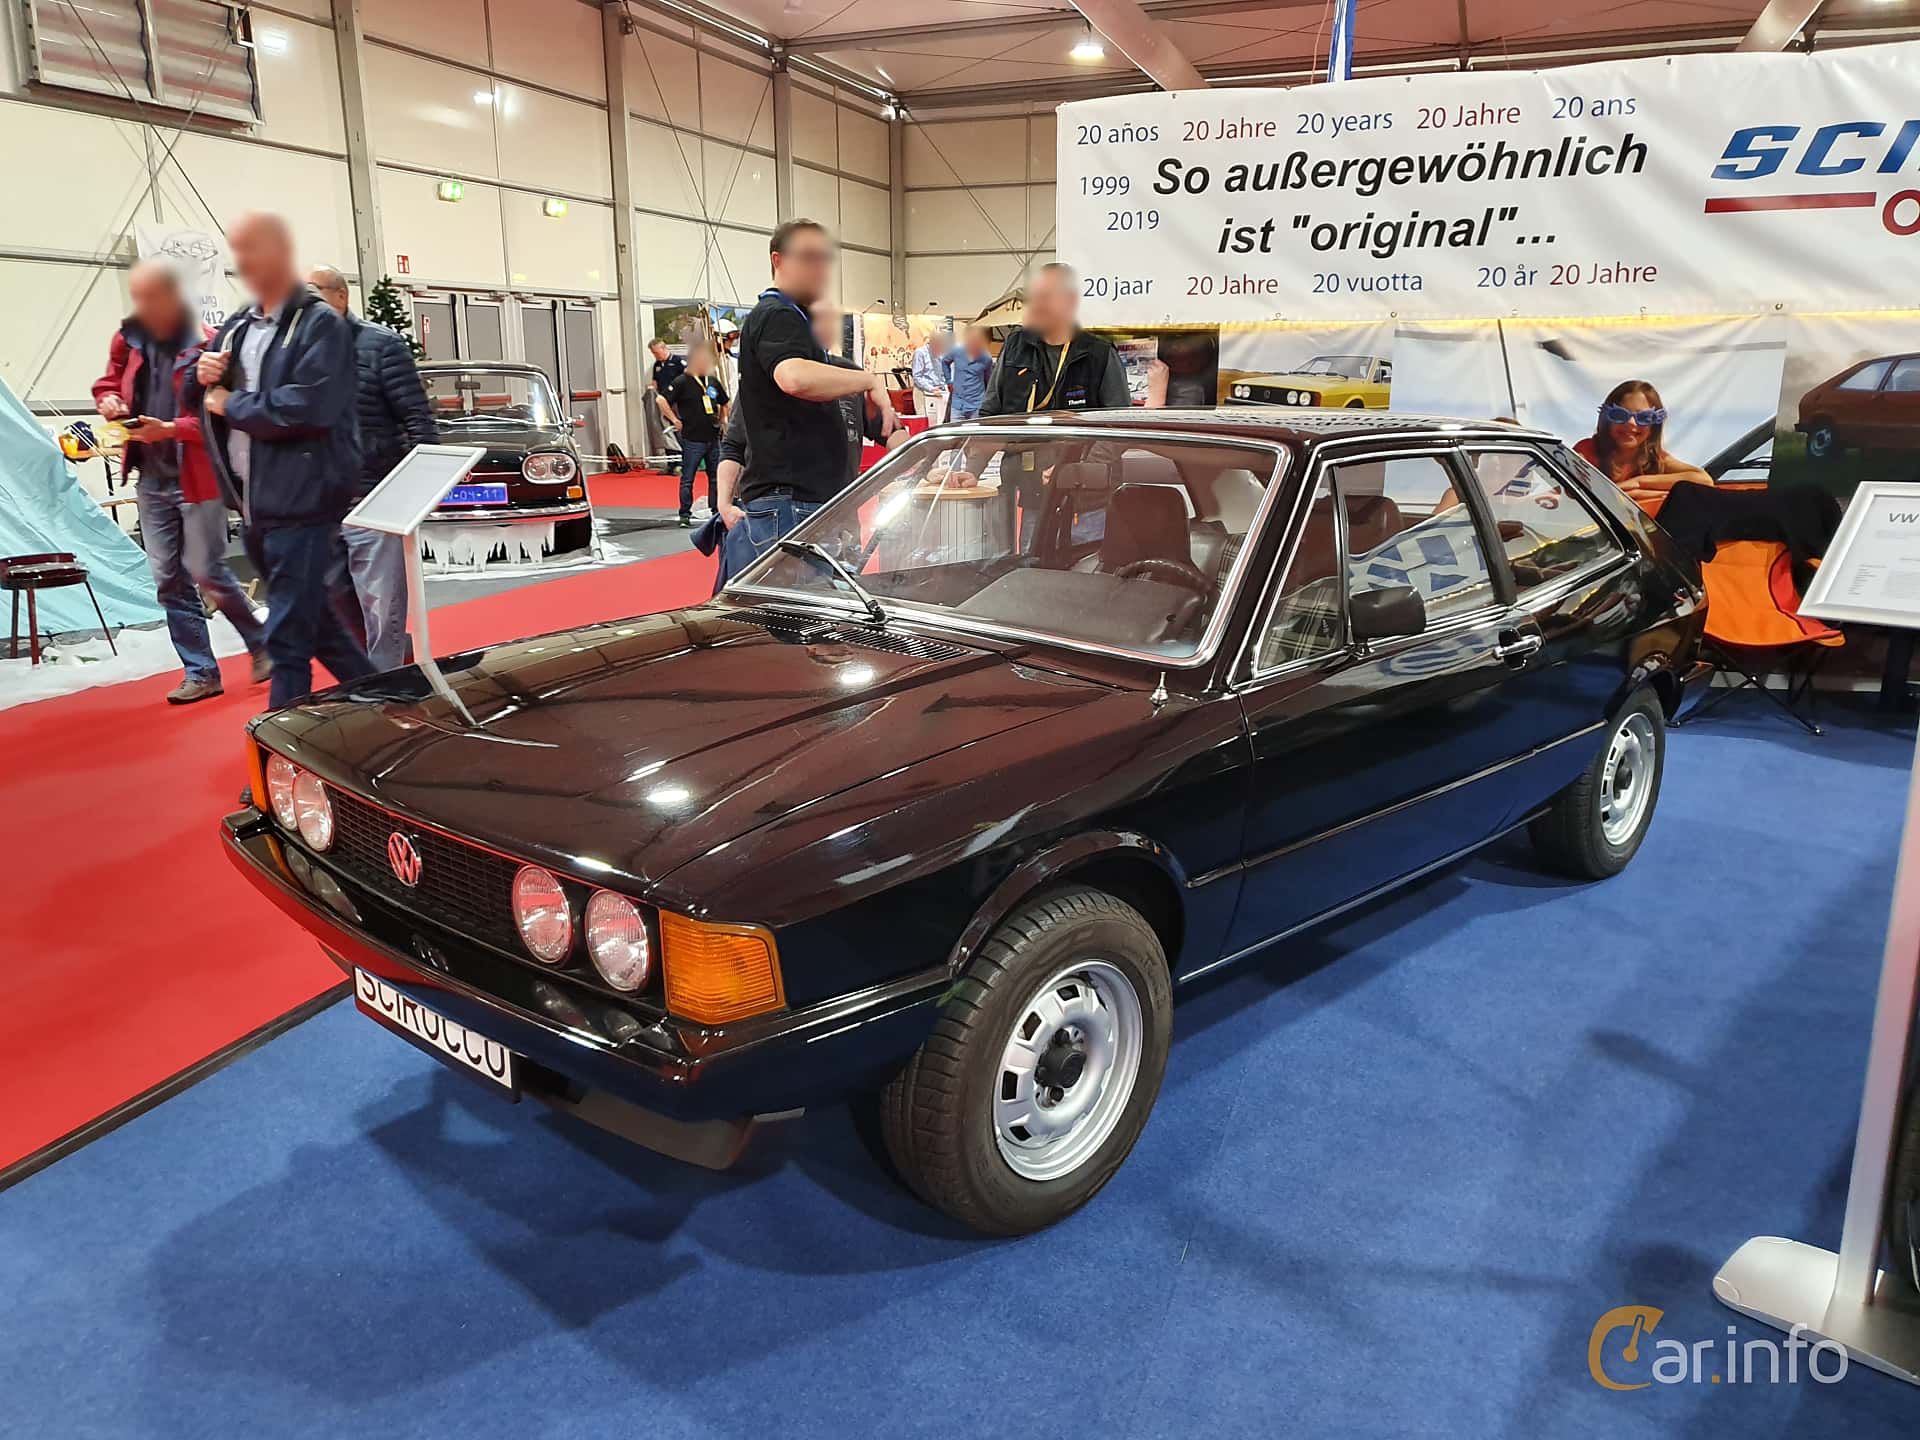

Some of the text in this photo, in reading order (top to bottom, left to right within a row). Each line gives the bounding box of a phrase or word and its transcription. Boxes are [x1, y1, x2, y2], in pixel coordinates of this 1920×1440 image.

[1077, 96, 1637, 145] 20 años 20 Jahre 20 years 20 Jahre 20 ans
[1152, 133, 1648, 196] So außergewöhnlich
[1080, 176, 1130, 195] 1999
[1106, 209, 1160, 231] 2019
[1218, 207, 1556, 260] ist "original"...
[1083, 261, 1658, 302] 20 jaar 20 Jahre 20 vuotta 20 år 20 Jahre
[1888, 512, 1919, 523] VW
